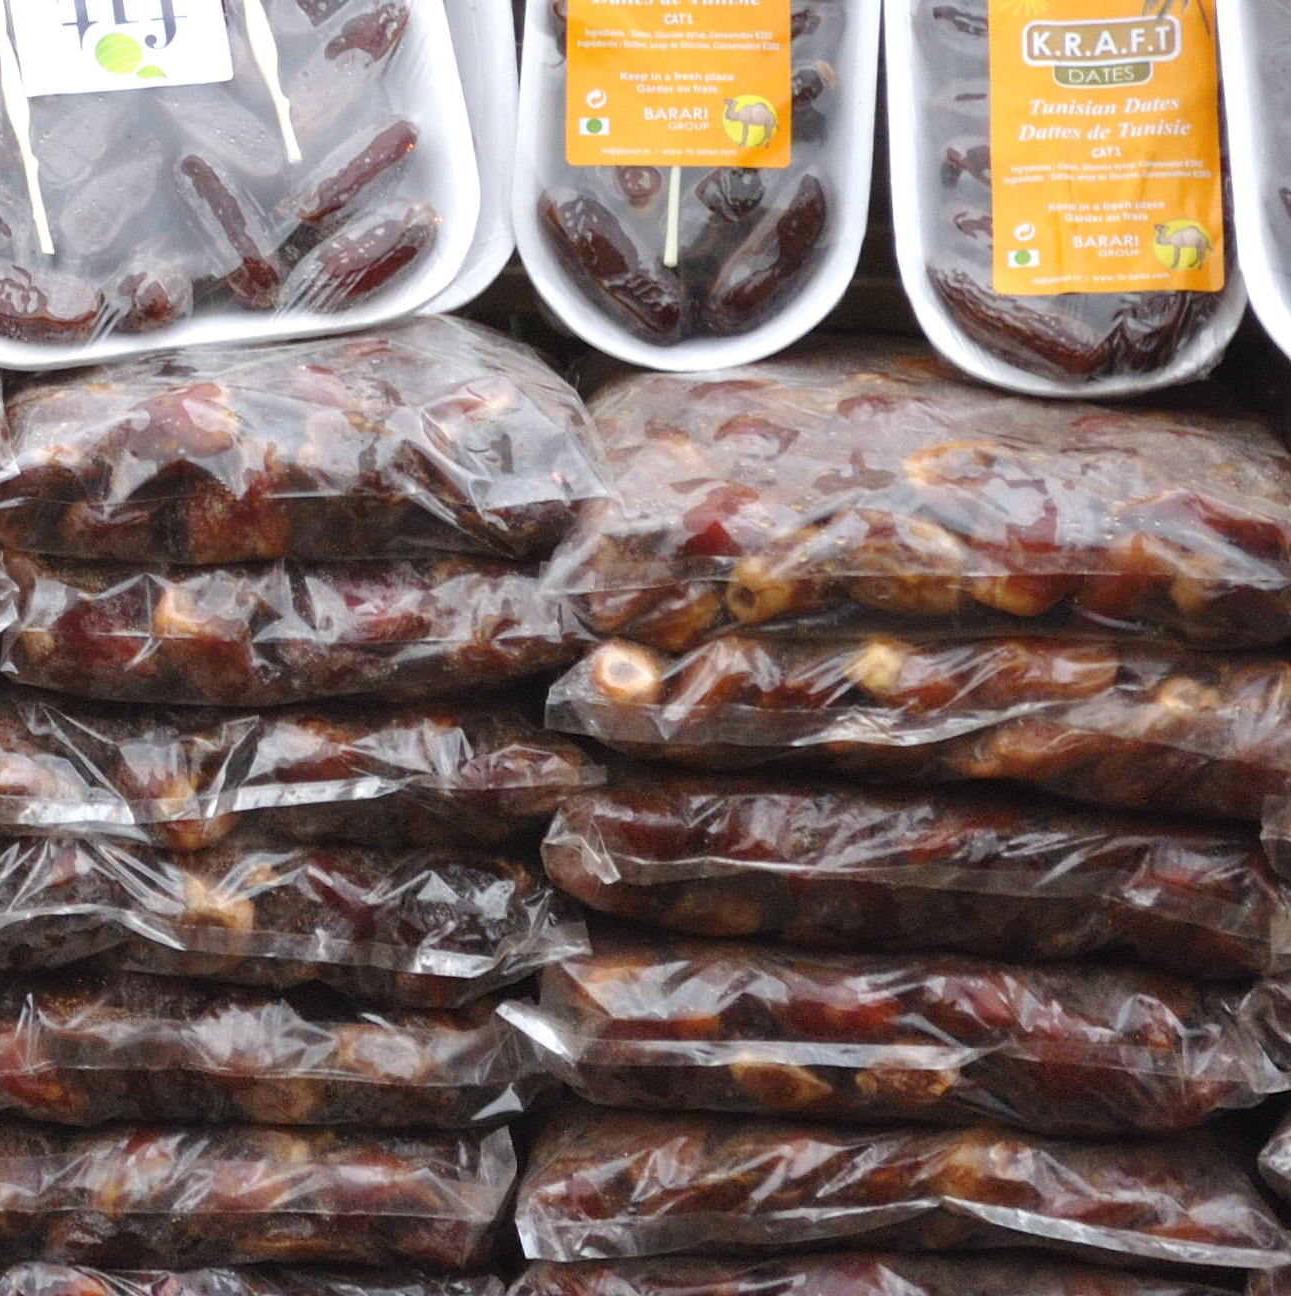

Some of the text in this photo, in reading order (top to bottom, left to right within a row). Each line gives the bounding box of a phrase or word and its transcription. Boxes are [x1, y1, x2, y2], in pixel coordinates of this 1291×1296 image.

[664, 13, 693, 25] CAT 1
[1032, 26, 1170, 57] K.R.A.F.T
[620, 72, 648, 83] Keep
[651, 72, 661, 81] in
[674, 72, 702, 82] fresh
[705, 72, 734, 83] place
[1069, 66, 1134, 83] DATES
[637, 84, 718, 94] Garder au frais
[1029, 97, 1180, 116] Tunisian Dates
[644, 107, 708, 121] BARARI
[668, 122, 709, 131] GROUP
[1018, 119, 1192, 141] Dattes de Tunisie
[1091, 146, 1121, 158] CAT 1
[1048, 203, 1076, 213] Keep
[1080, 202, 1090, 212] in
[1103, 201, 1132, 211] fresh
[1135, 200, 1165, 211] place
[1065, 211, 1148, 223] Garder au frais
[1073, 235, 1139, 248] BARARI
[1098, 249, 1140, 258] GROUP
